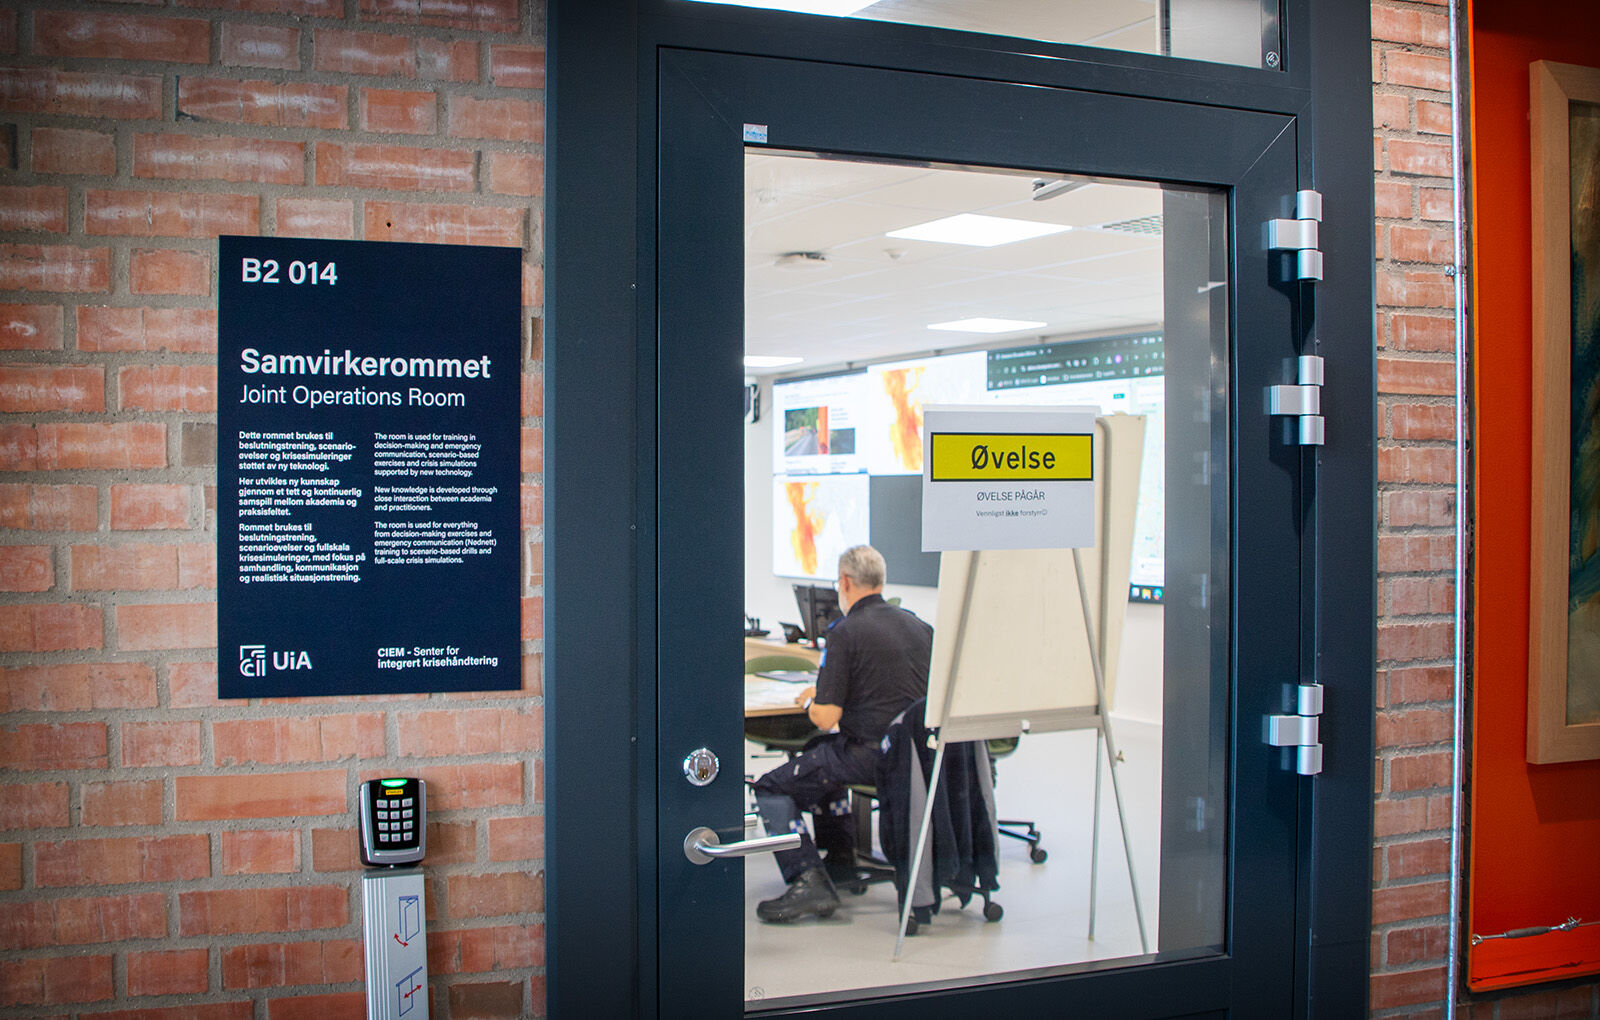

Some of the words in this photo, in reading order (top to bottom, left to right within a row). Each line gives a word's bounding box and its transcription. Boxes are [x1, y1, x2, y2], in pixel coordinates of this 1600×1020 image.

[241, 258, 280, 284] B2
[288, 261, 338, 286] 014
[240, 348, 491, 379] Samvirkerommet
[239, 385, 287, 404] Joint
[292, 385, 402, 409] Operations
[408, 388, 465, 407] Room
[239, 431, 261, 440] Dette
[263, 432, 294, 440] rommet
[295, 432, 323, 440] brukes
[325, 432, 333, 440] til
[374, 432, 387, 440] The
[443, 433, 468, 442] training
[469, 433, 476, 441] in
[318, 442, 356, 451] scenario-
[374, 442, 429, 450] decision-making
[270, 453, 281, 461] og
[282, 451, 352, 462] krisesimuleringer
[971, 445, 1056, 470] Øvelse
[278, 463, 288, 472] ny
[410, 469, 419, 477] by
[239, 477, 254, 485] Her
[255, 477, 287, 486] utvikles
[289, 479, 299, 487] ny
[300, 477, 340, 487] kunnskap
[238, 487, 274, 497] gjennom
[275, 488, 285, 496] et
[286, 488, 300, 496] tett
[301, 489, 313, 498] og
[314, 487, 362, 498] kontinuerlig
[391, 486, 428, 494] knowledge
[436, 486, 471, 494] developed
[471, 486, 498, 495] through
[976, 491, 1013, 501] ØVELSE
[1014, 489, 1045, 501] PÅGÅR
[238, 497, 272, 507] samspill
[274, 497, 304, 506] mellom
[305, 497, 345, 506] akademia
[346, 499, 357, 507] og
[239, 523, 273, 531] Rommet
[274, 523, 302, 531] brukes
[304, 523, 312, 531] til
[443, 521, 478, 530] everything
[391, 530, 446, 538] decision-making
[304, 545, 315, 553] og
[316, 543, 350, 551] fullskala
[374, 540, 412, 548] emergency
[374, 548, 400, 556] training
[312, 553, 330, 561] med
[331, 553, 354, 561] fokus
[355, 553, 366, 562] på
[295, 563, 359, 572] kommunikasjon
[239, 575, 250, 584] og
[251, 574, 288, 582] realistisk
[377, 647, 405, 657] CIEM
[413, 647, 443, 656] Senter
[446, 646, 460, 656] for
[273, 651, 313, 670] UiA
[377, 657, 421, 671] integrert
[422, 655, 498, 667] krisehåndtering
